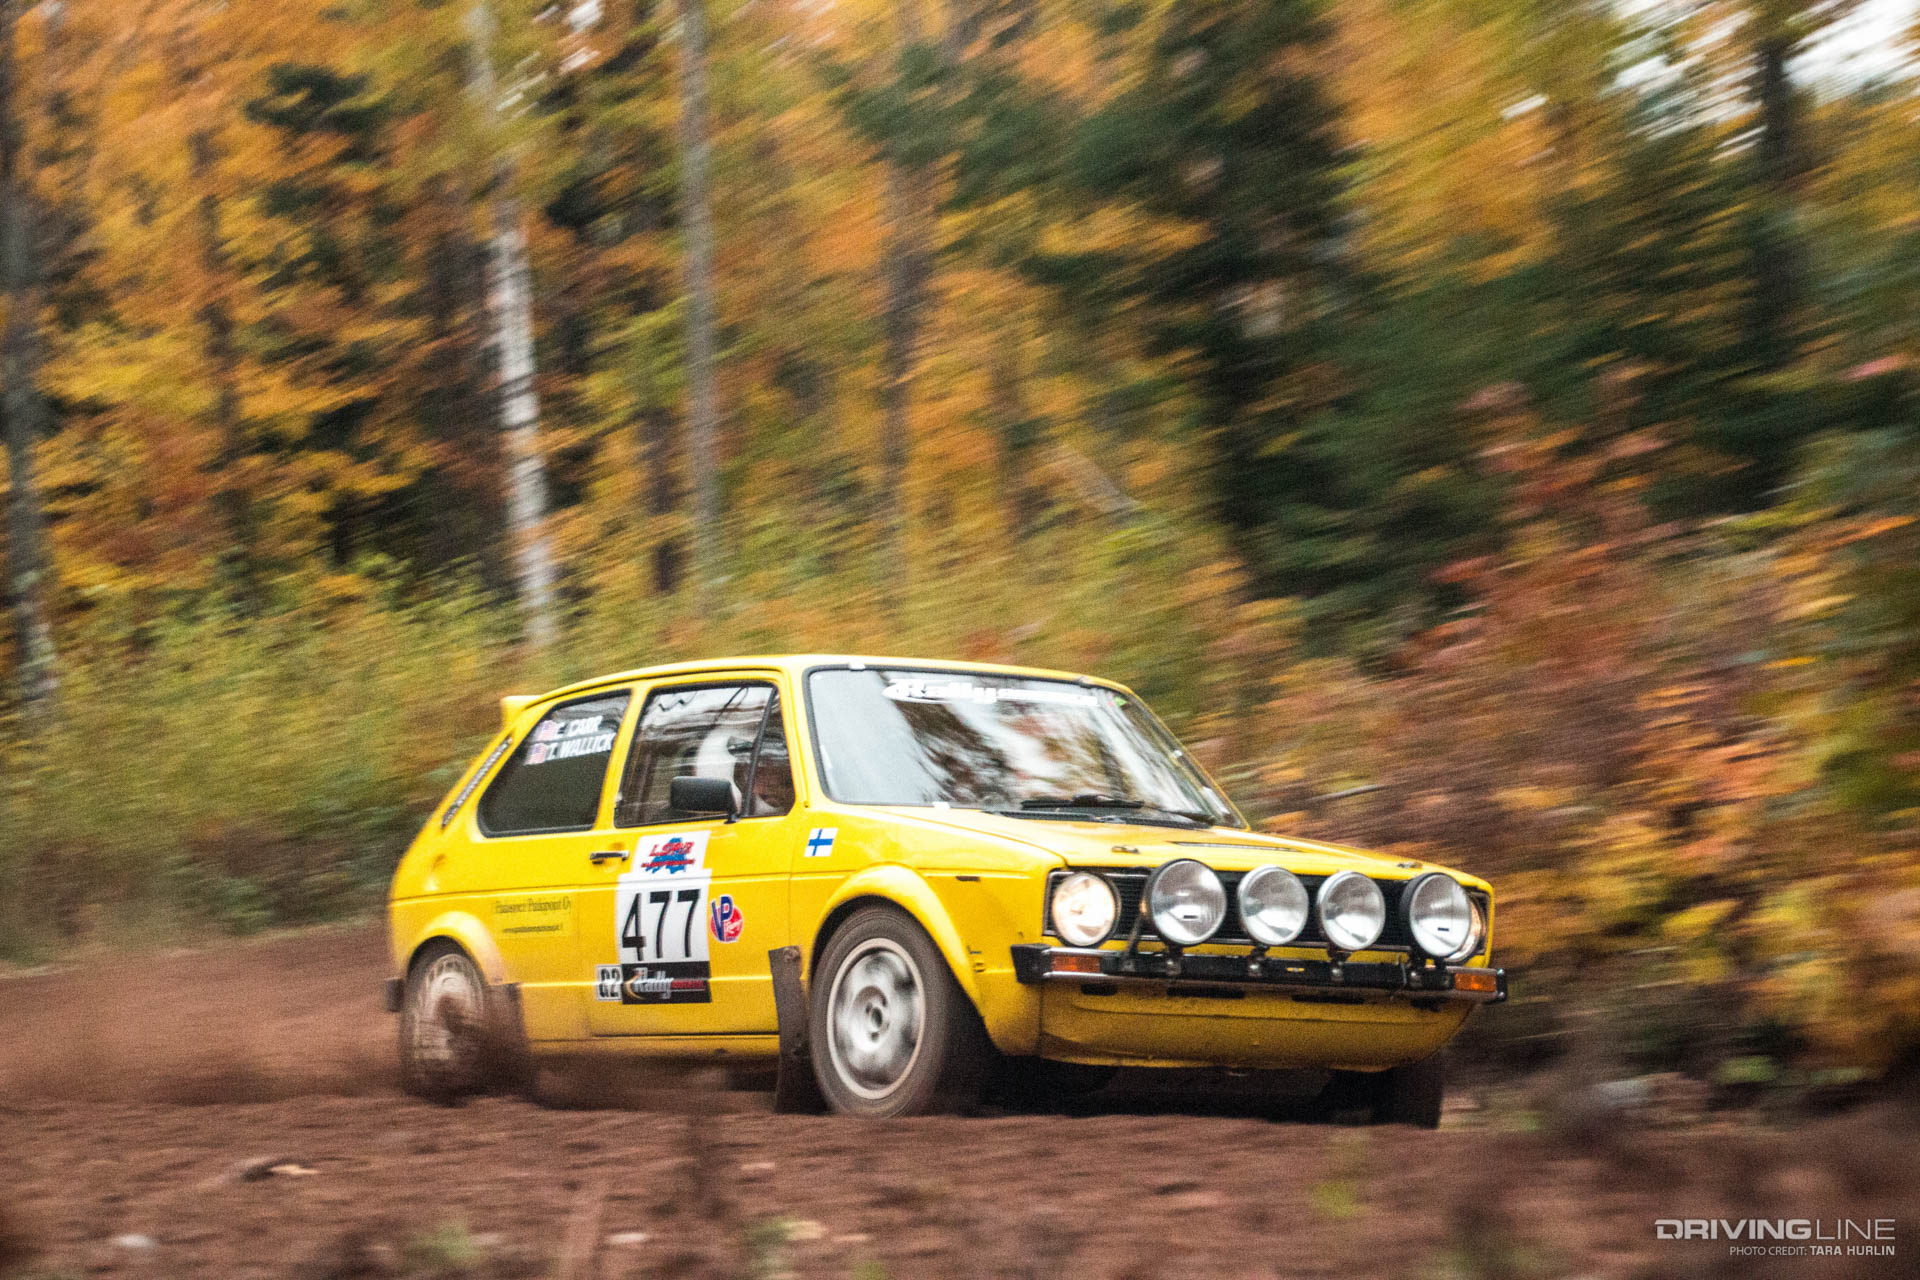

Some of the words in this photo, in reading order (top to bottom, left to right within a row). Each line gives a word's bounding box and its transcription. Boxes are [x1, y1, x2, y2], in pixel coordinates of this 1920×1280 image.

[560, 732, 617, 758] WALLICK
[621, 888, 701, 962] 477
[711, 896, 734, 942] VP
[632, 967, 675, 999] Rally
